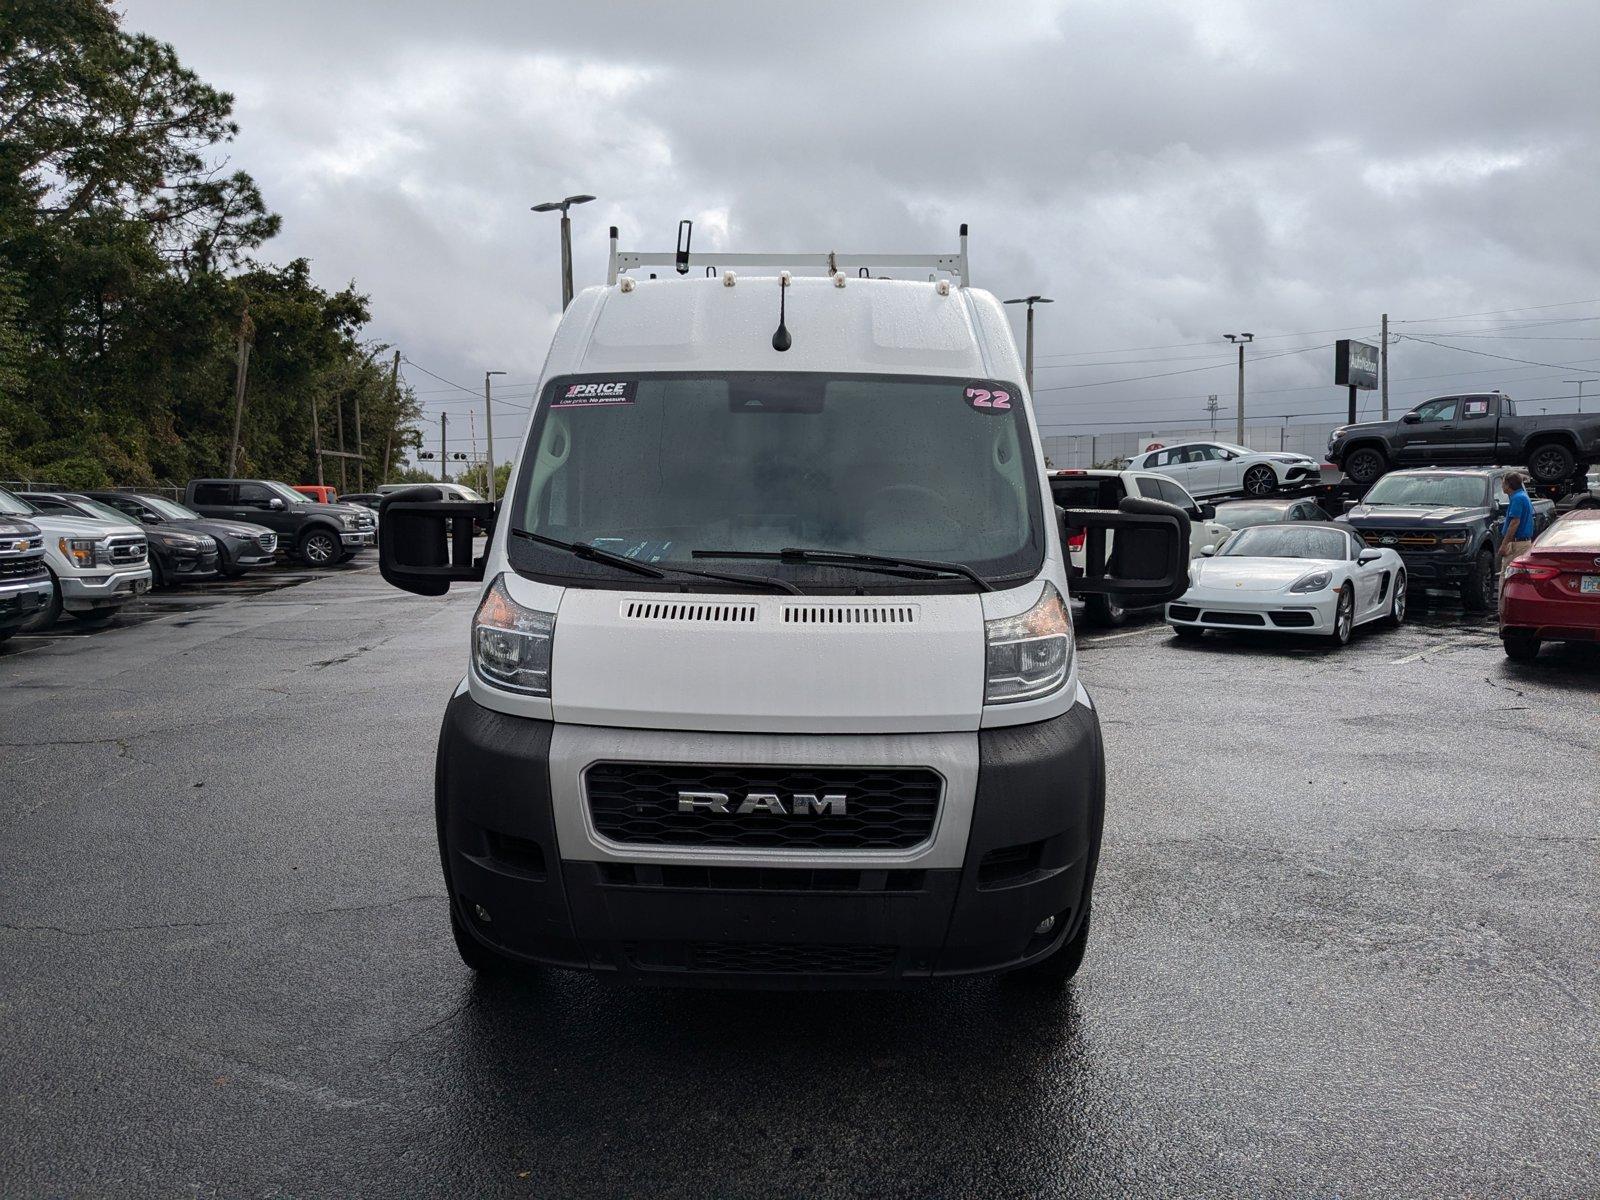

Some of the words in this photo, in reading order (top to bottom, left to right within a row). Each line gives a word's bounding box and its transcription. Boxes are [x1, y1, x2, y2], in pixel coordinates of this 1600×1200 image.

[567, 383, 627, 395] 1PRICE
[966, 388, 1011, 409] '22
[678, 791, 847, 815] RAM
